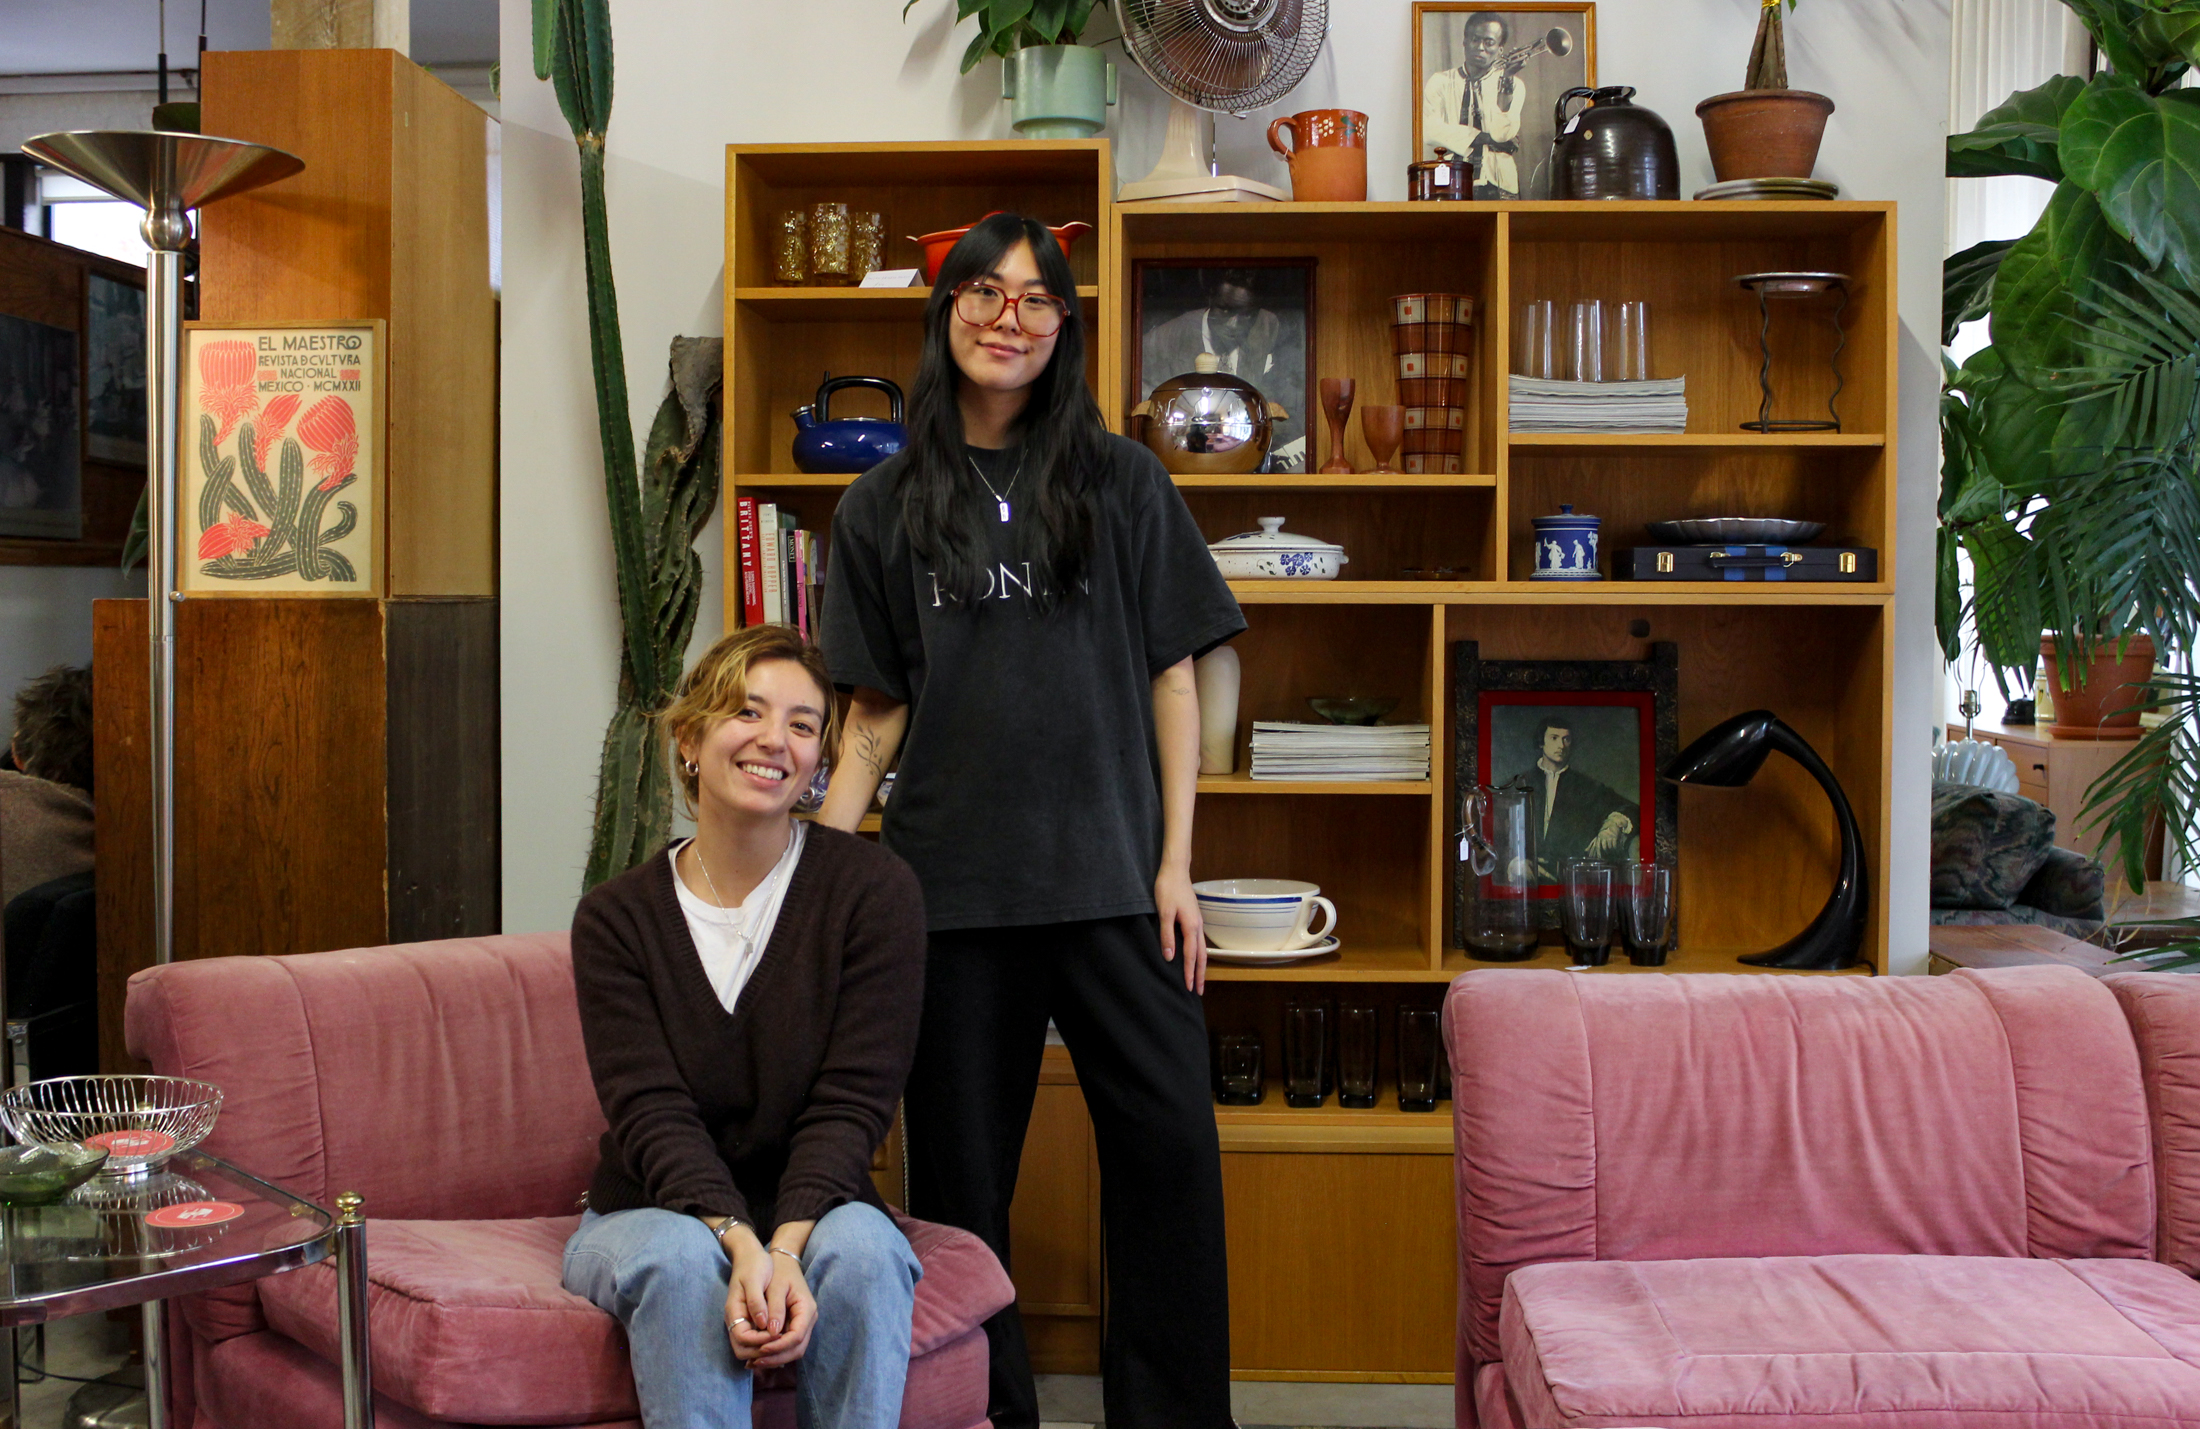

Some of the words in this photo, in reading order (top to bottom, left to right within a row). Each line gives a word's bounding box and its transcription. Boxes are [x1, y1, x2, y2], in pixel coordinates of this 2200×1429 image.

[258, 336, 277, 351] EL
[283, 335, 362, 351] MAESTRO
[258, 355, 299, 367] REVISTA
[309, 354, 361, 366] CVLTVRA
[280, 367, 337, 379] NACIONAL
[258, 381, 304, 393] MEXICO
[313, 381, 361, 392] MCMXXII
[739, 501, 752, 567] BRITTANY
[765, 532, 776, 561] EDWARD
[767, 565, 778, 592] HOPPER
